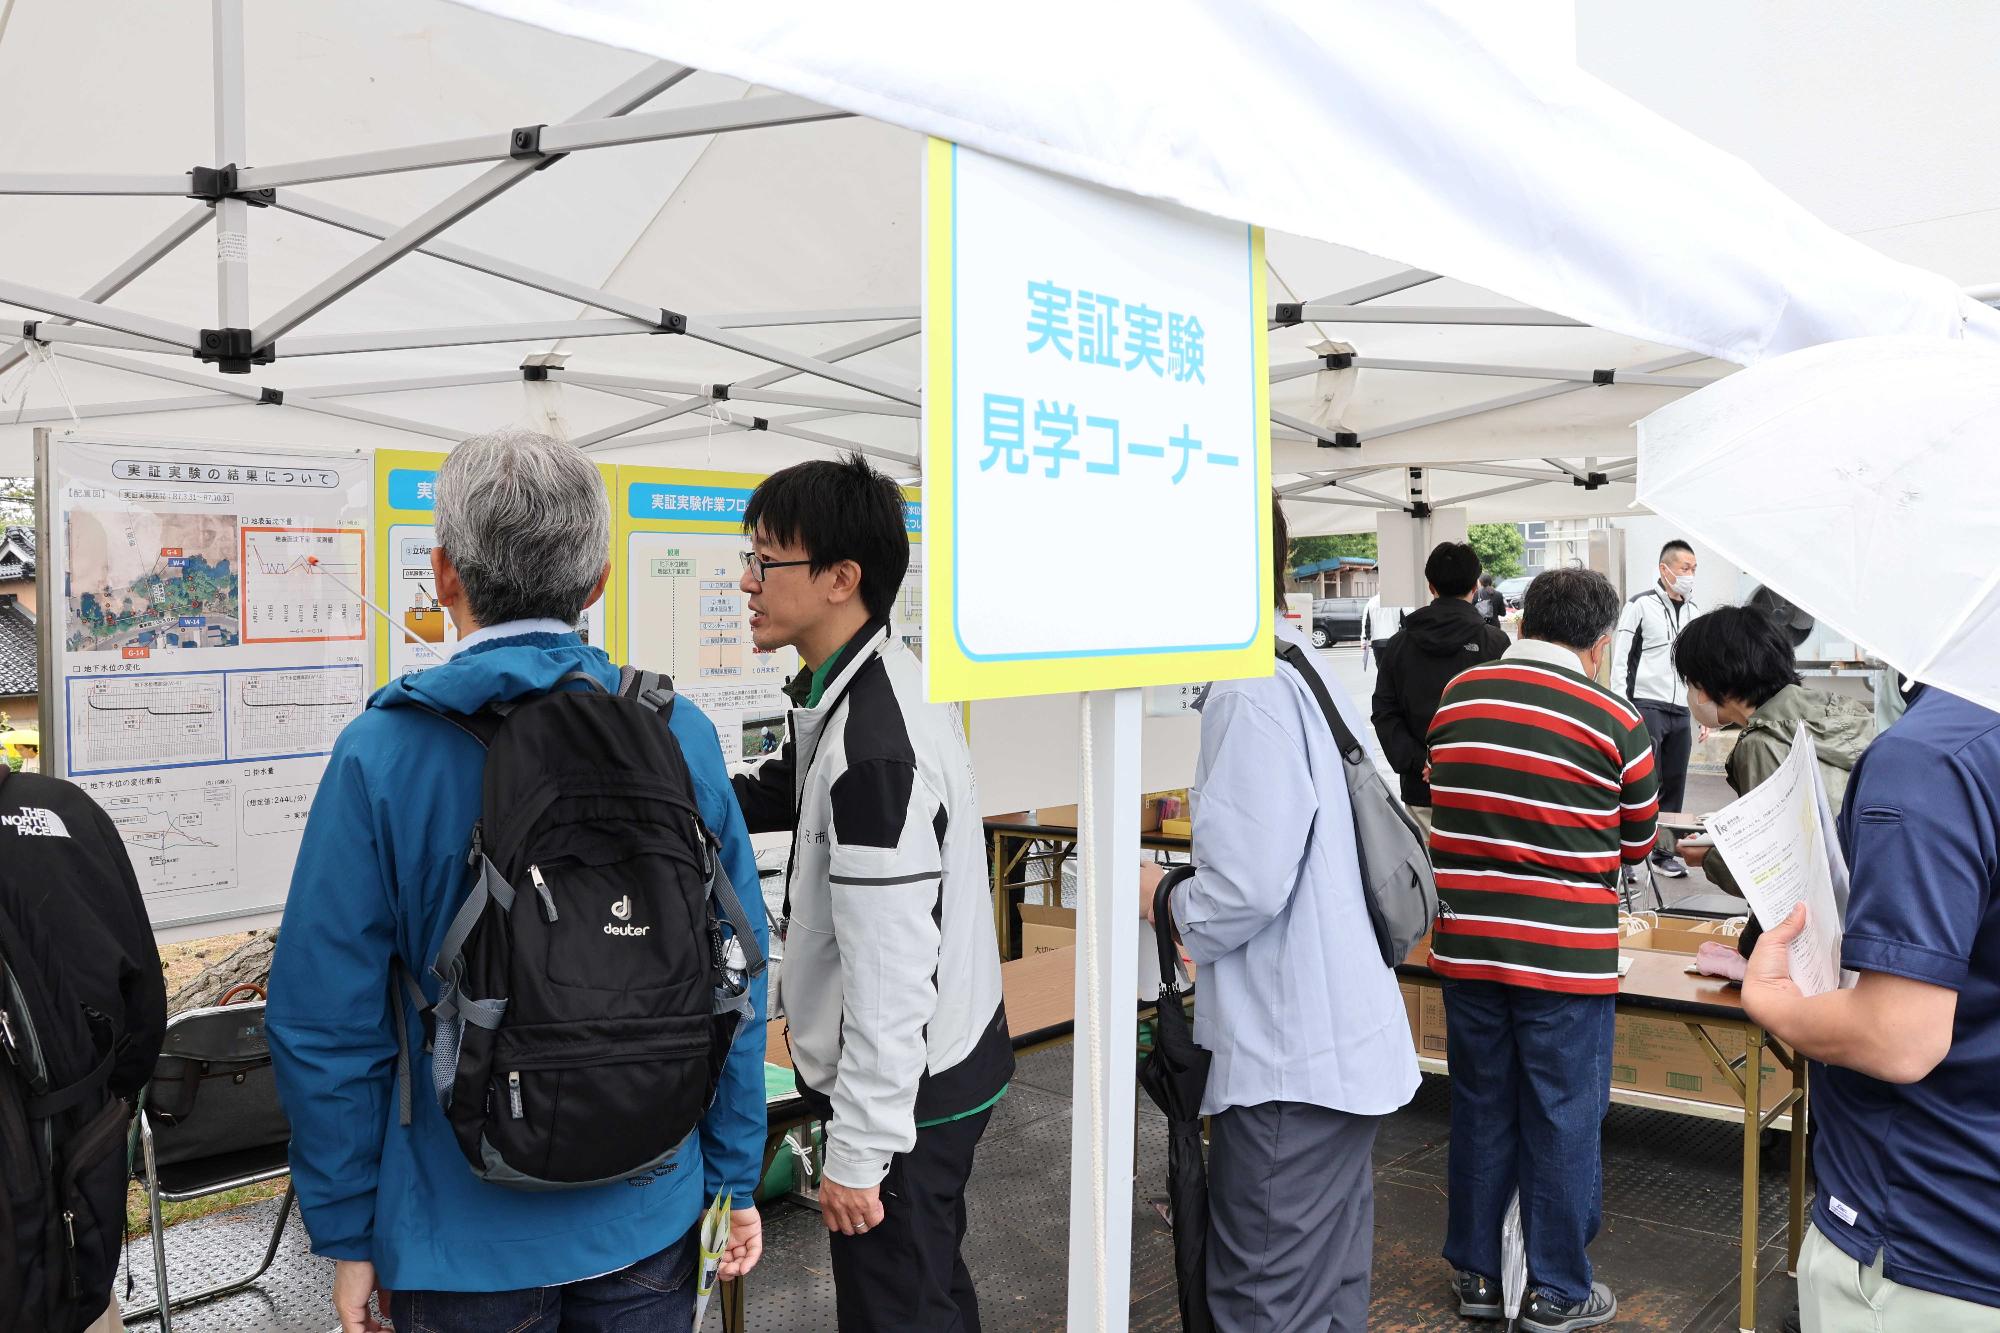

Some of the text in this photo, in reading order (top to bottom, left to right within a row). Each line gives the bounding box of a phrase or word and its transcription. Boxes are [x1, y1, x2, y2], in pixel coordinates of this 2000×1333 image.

[1026, 280, 1206, 385] 実証実験
[979, 393, 1239, 485] 見学コーナー
[127, 463, 329, 485] 実証実験の結果について
[416, 481, 436, 499] 実
[651, 493, 748, 512] 実証実験作業フロ
[83, 663, 141, 673] 地下水位の変化
[253, 767, 274, 776] 排水量
[90, 776, 162, 790] 地下水位の変化断面
[19, 806, 46, 817] THE
[294, 811, 310, 820] 実測
[1, 815, 48, 827] NORTH
[17, 825, 51, 836] FACE
[603, 922, 650, 936] deuter
